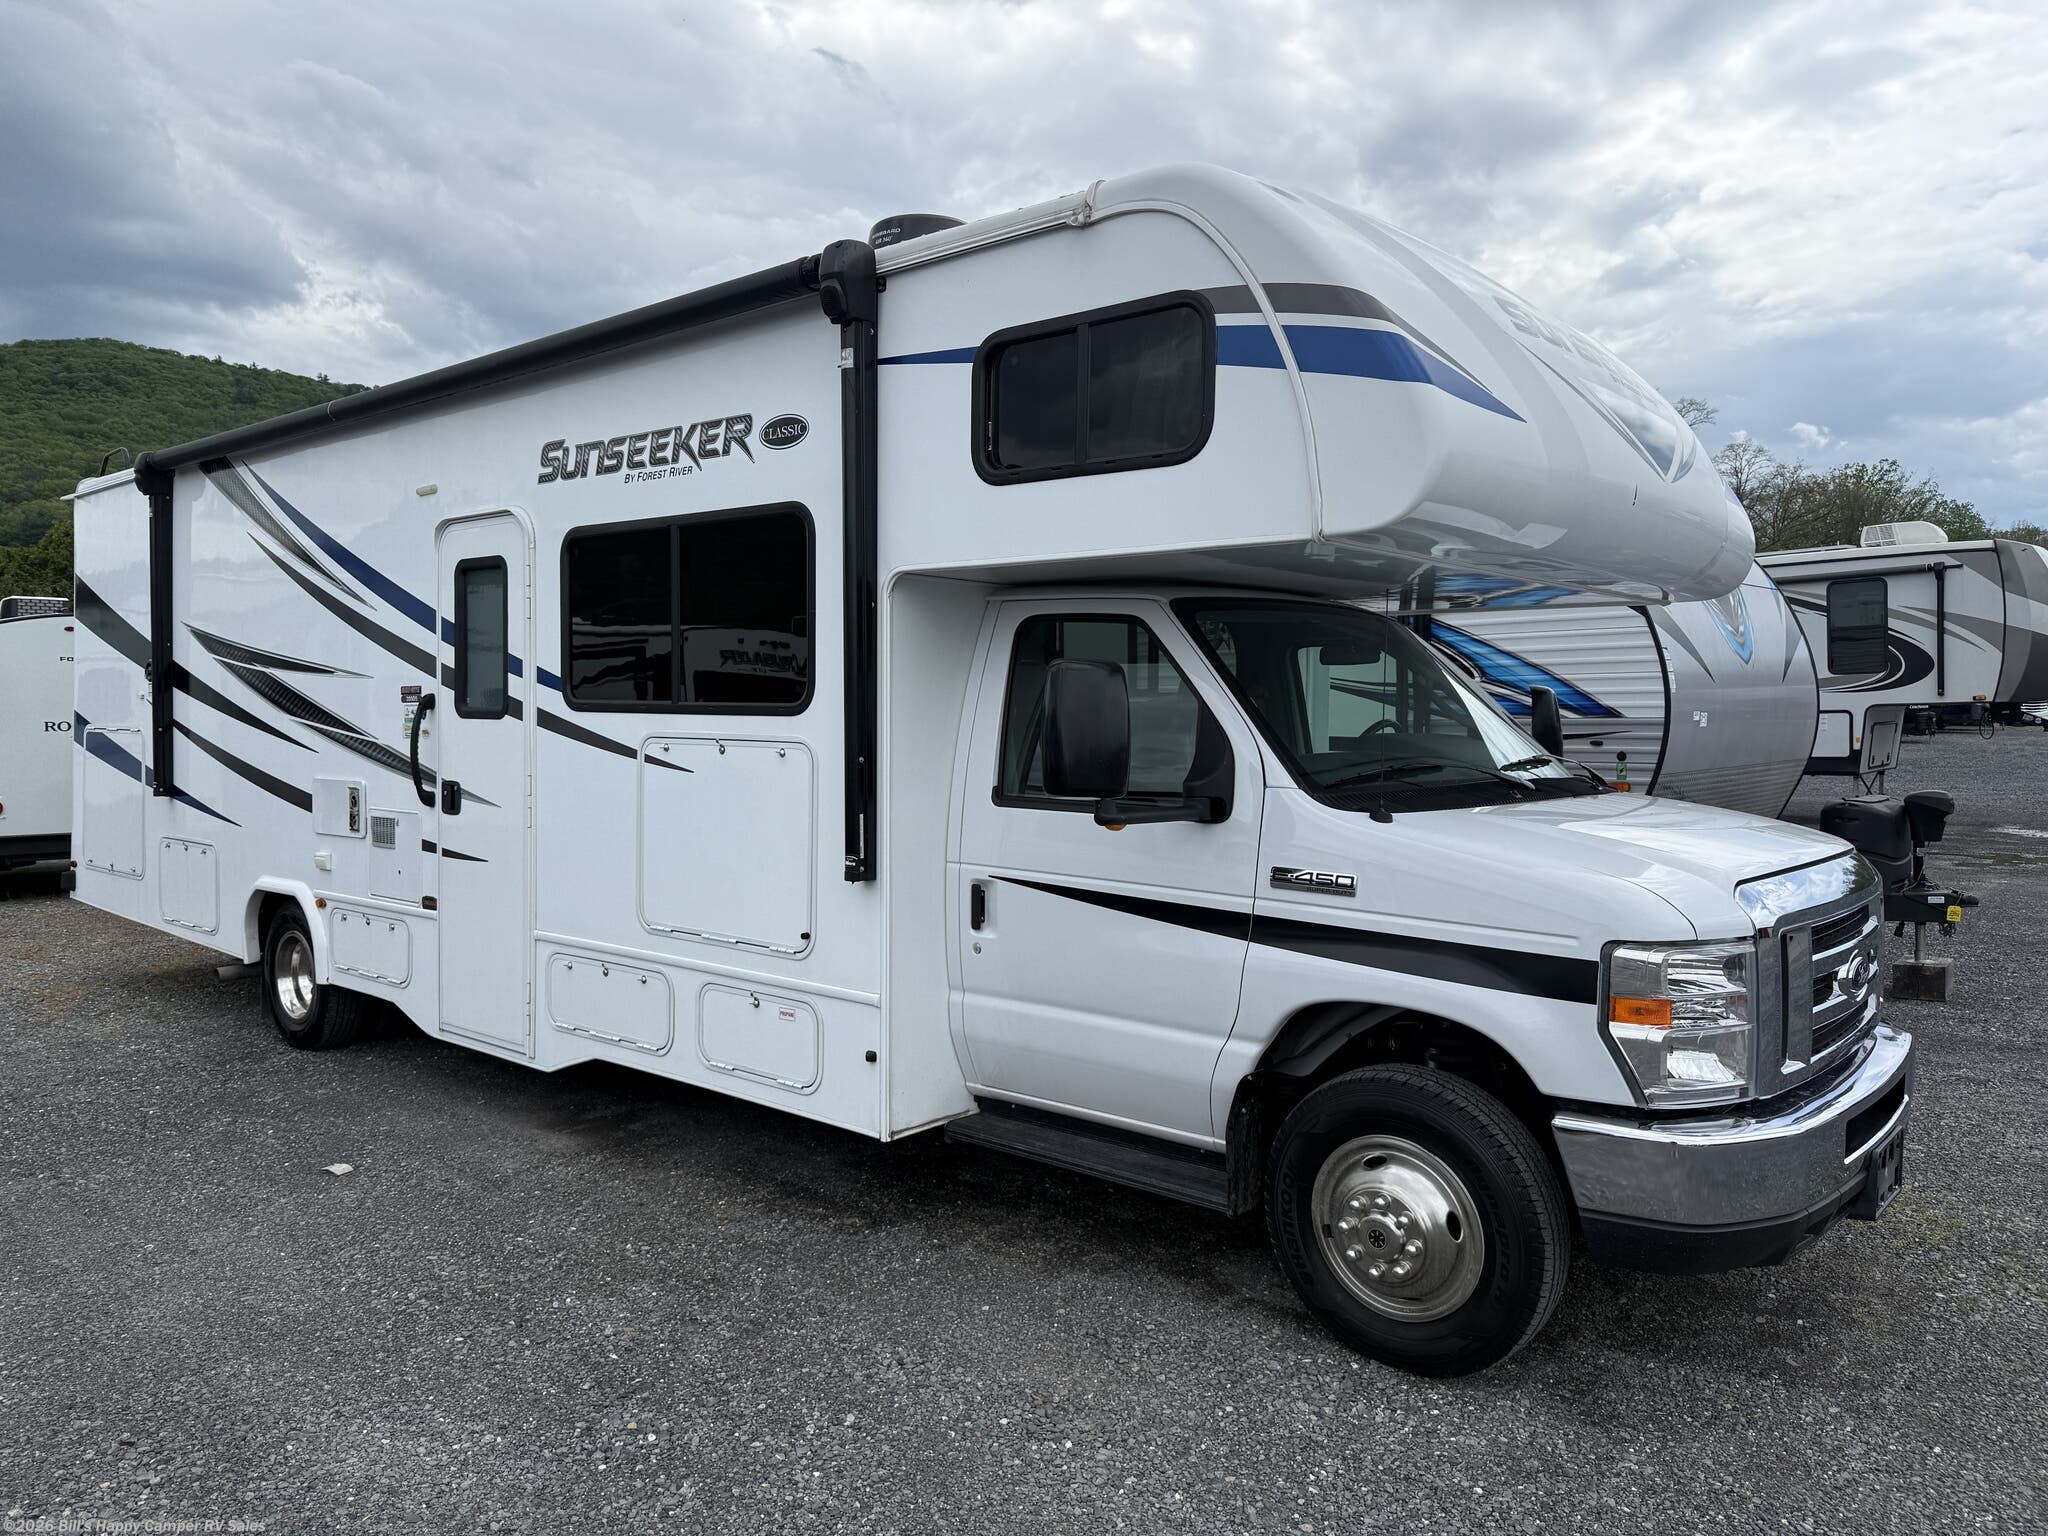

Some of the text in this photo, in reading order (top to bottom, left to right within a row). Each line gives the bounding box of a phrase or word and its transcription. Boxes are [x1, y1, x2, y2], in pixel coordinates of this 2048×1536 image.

[761, 420, 806, 440] CLASSIC
[537, 413, 755, 485] SUNSEEKER
[624, 465, 693, 484] BY FOREST RIVER
[44, 721, 72, 732] RO
[1270, 867, 1356, 888] E-450
